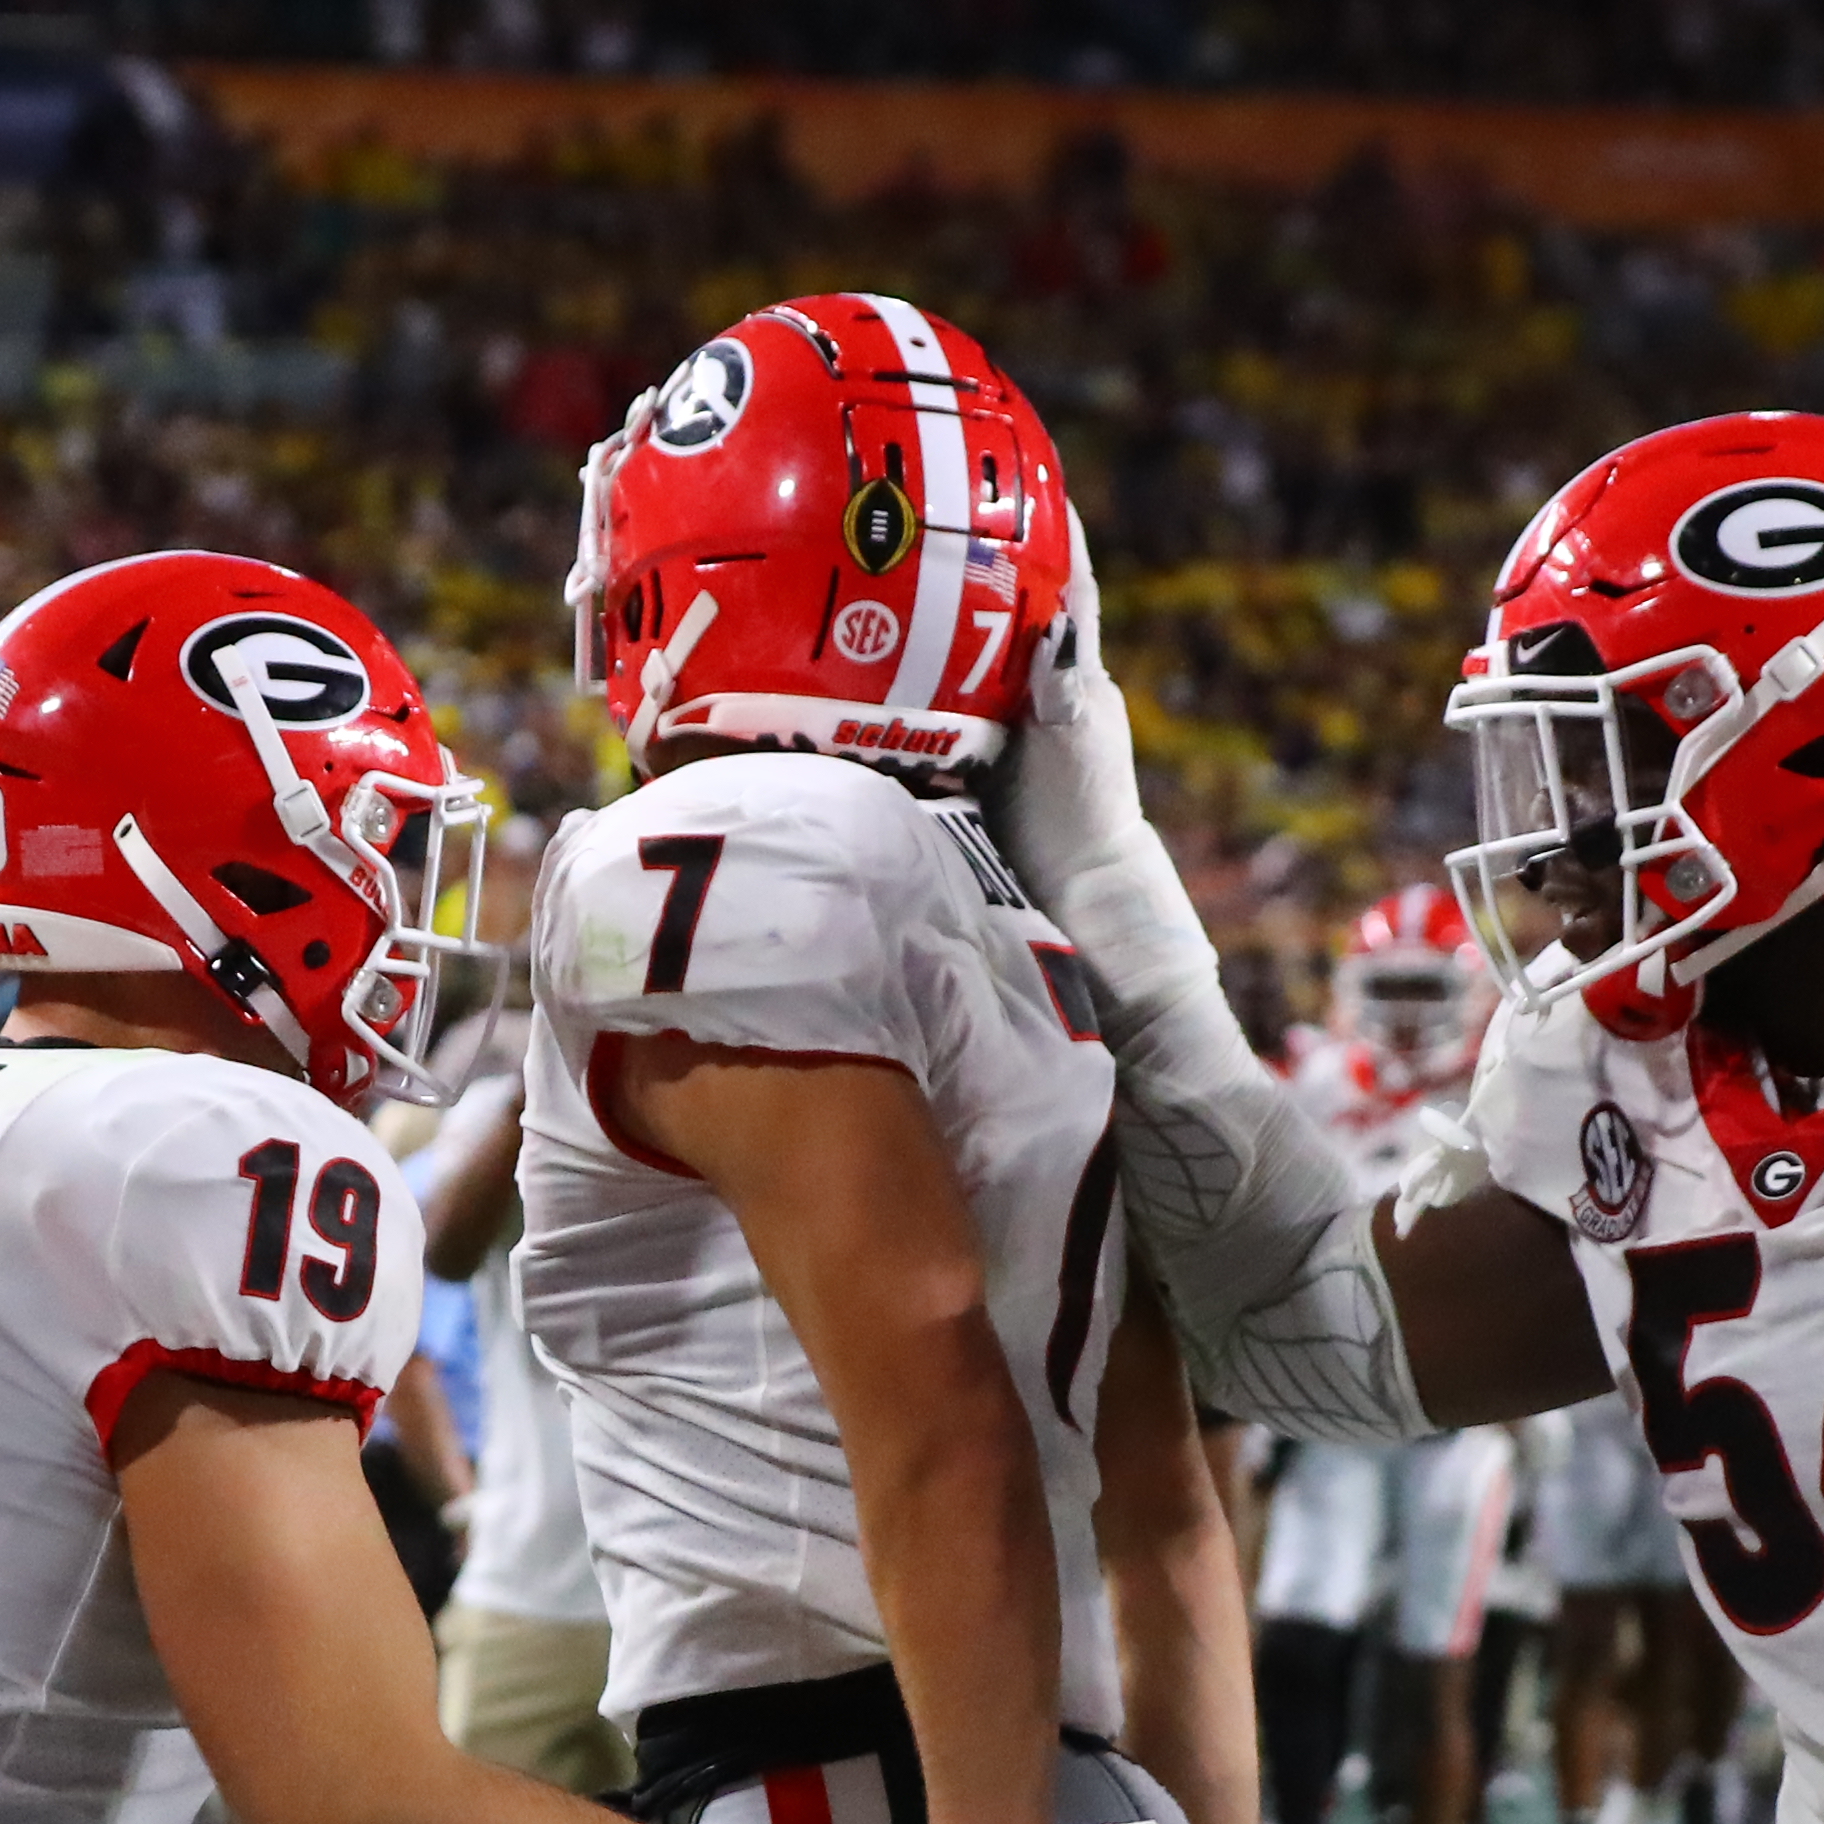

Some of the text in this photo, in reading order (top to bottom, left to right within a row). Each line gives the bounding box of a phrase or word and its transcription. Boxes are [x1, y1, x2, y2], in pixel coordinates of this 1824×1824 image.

[188, 617, 365, 721] G
[841, 608, 891, 656] SEC
[958, 610, 1012, 695] 7
[637, 834, 726, 996] 7
[1583, 1108, 1637, 1205] SEC
[1752, 1151, 1806, 1200] G
[239, 1137, 381, 1323] 19
